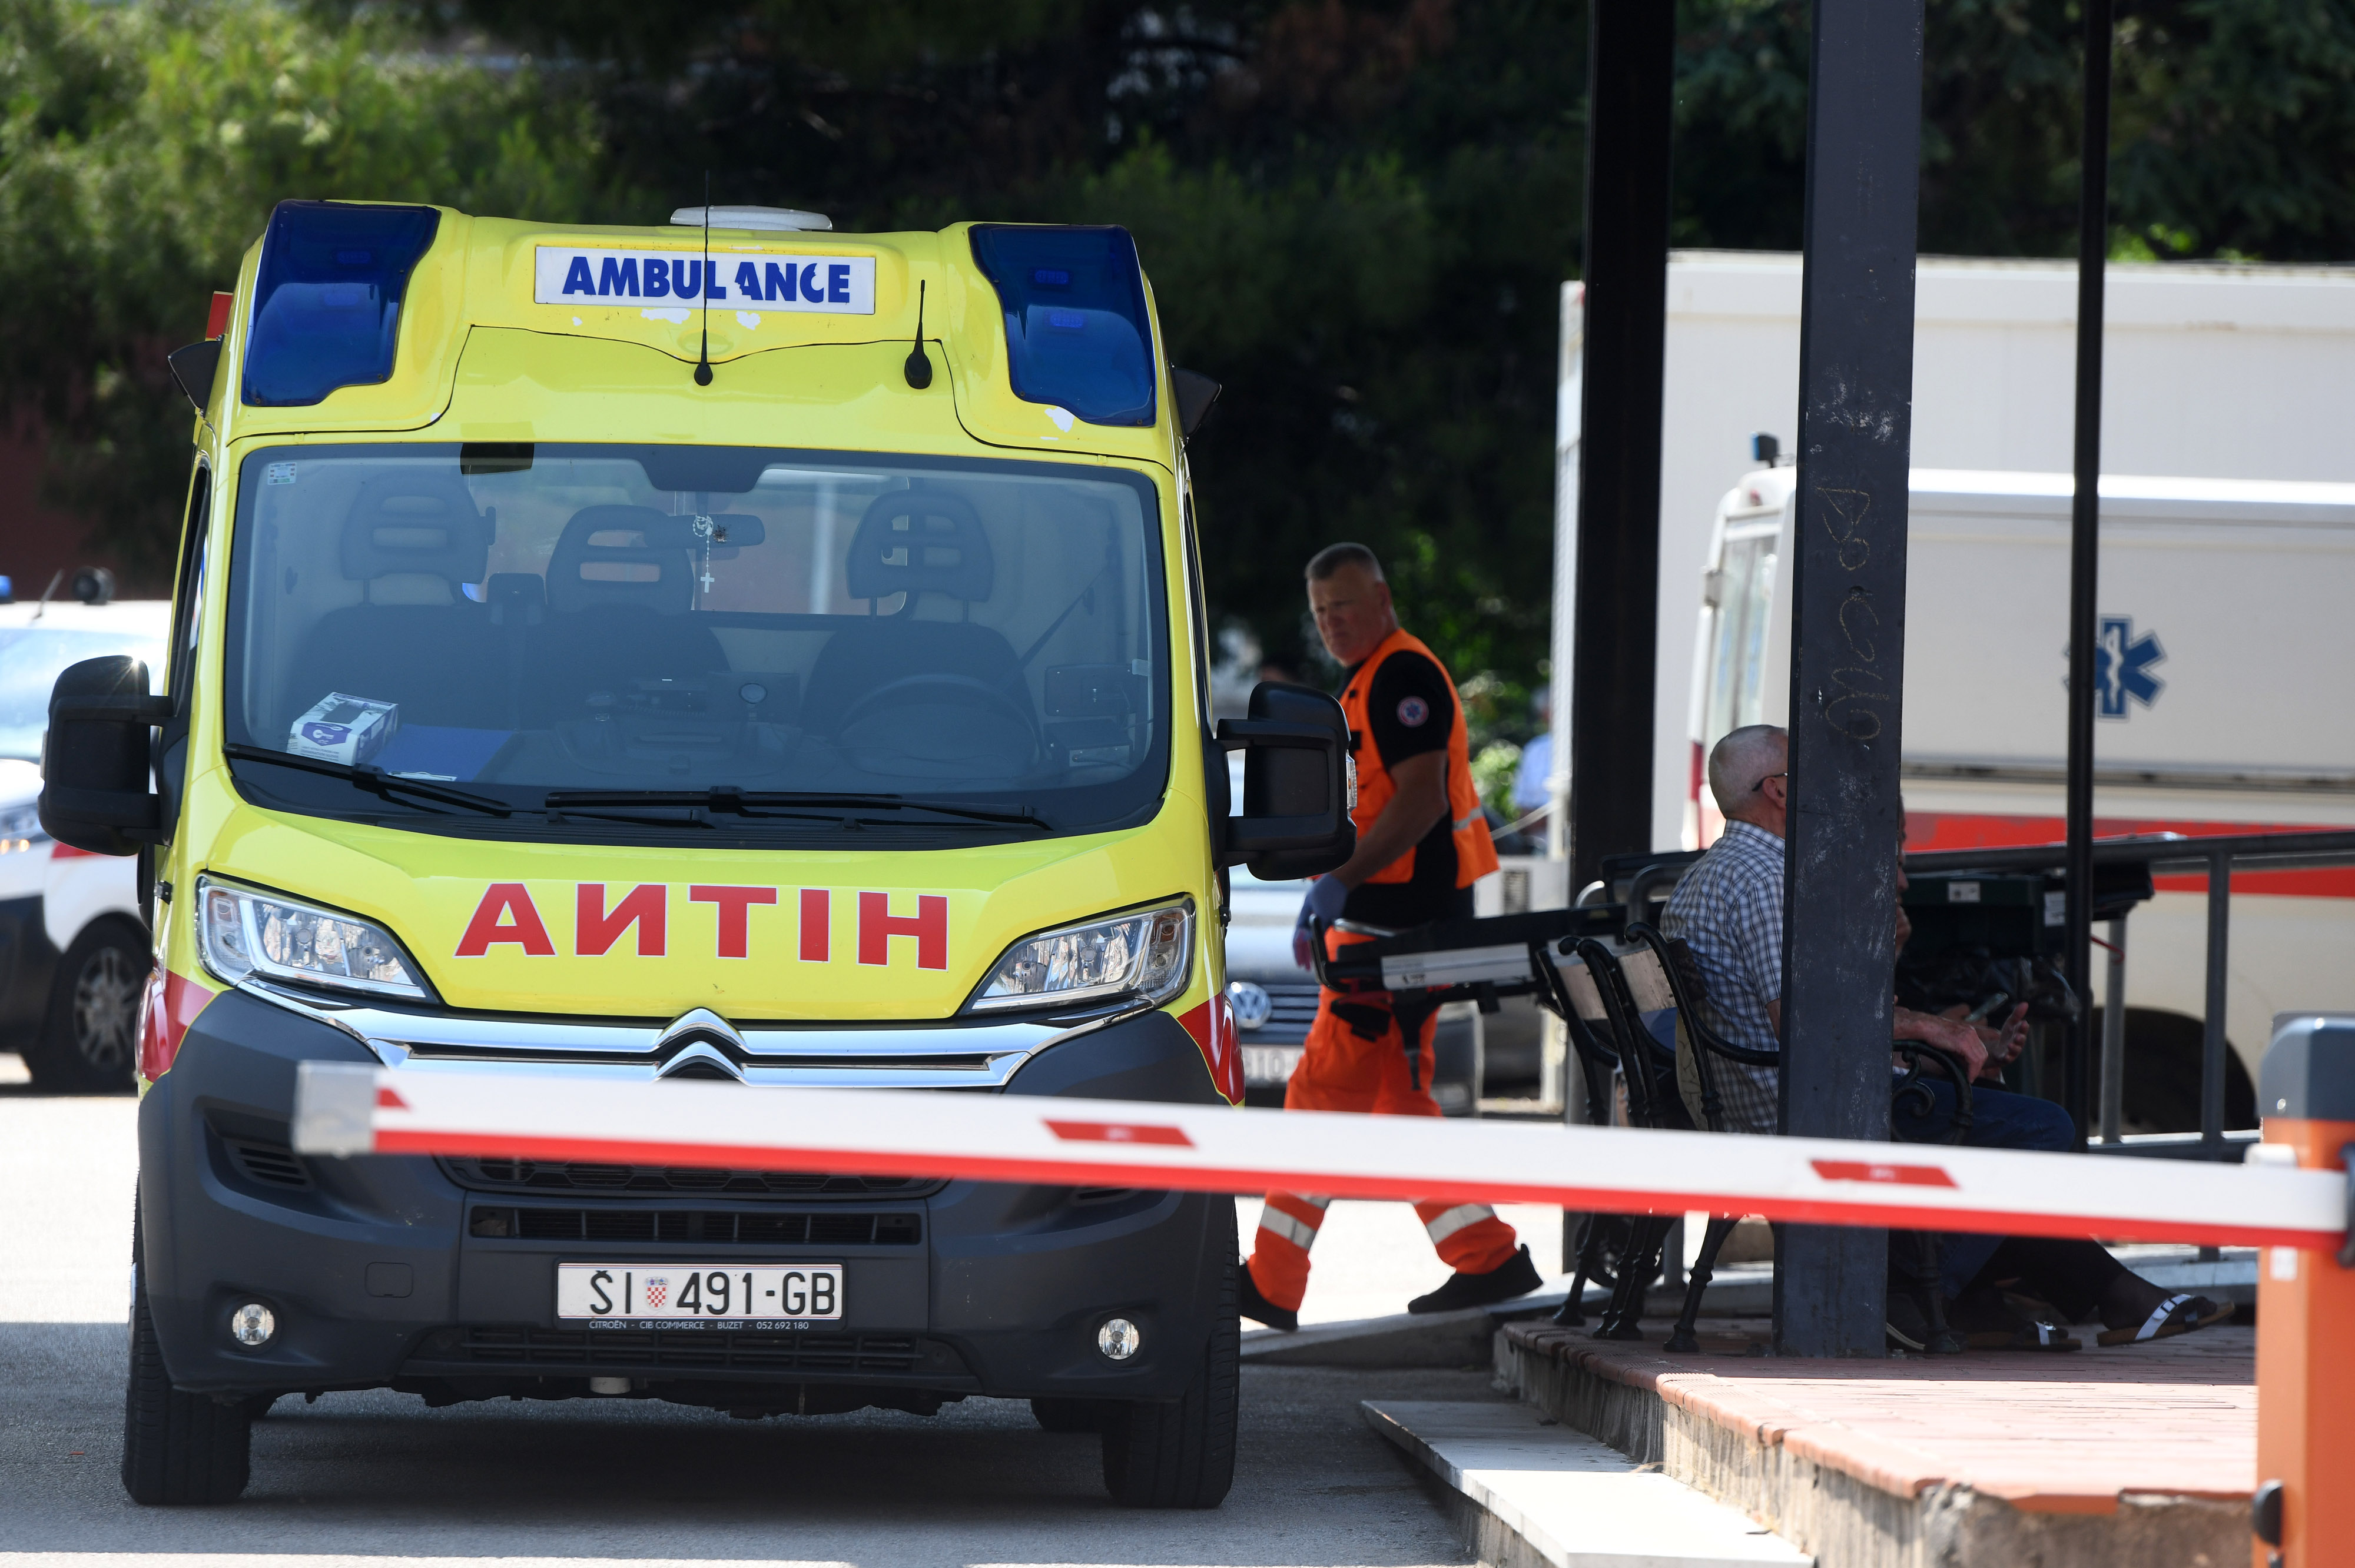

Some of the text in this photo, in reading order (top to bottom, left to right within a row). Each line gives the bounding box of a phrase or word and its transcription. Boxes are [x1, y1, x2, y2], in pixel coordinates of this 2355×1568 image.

[562, 255, 850, 303] AMBULANCE
[676, 1271, 835, 1315] 491-GB
[589, 1320, 626, 1329] CITROËN
[756, 1321, 772, 1330] 052
